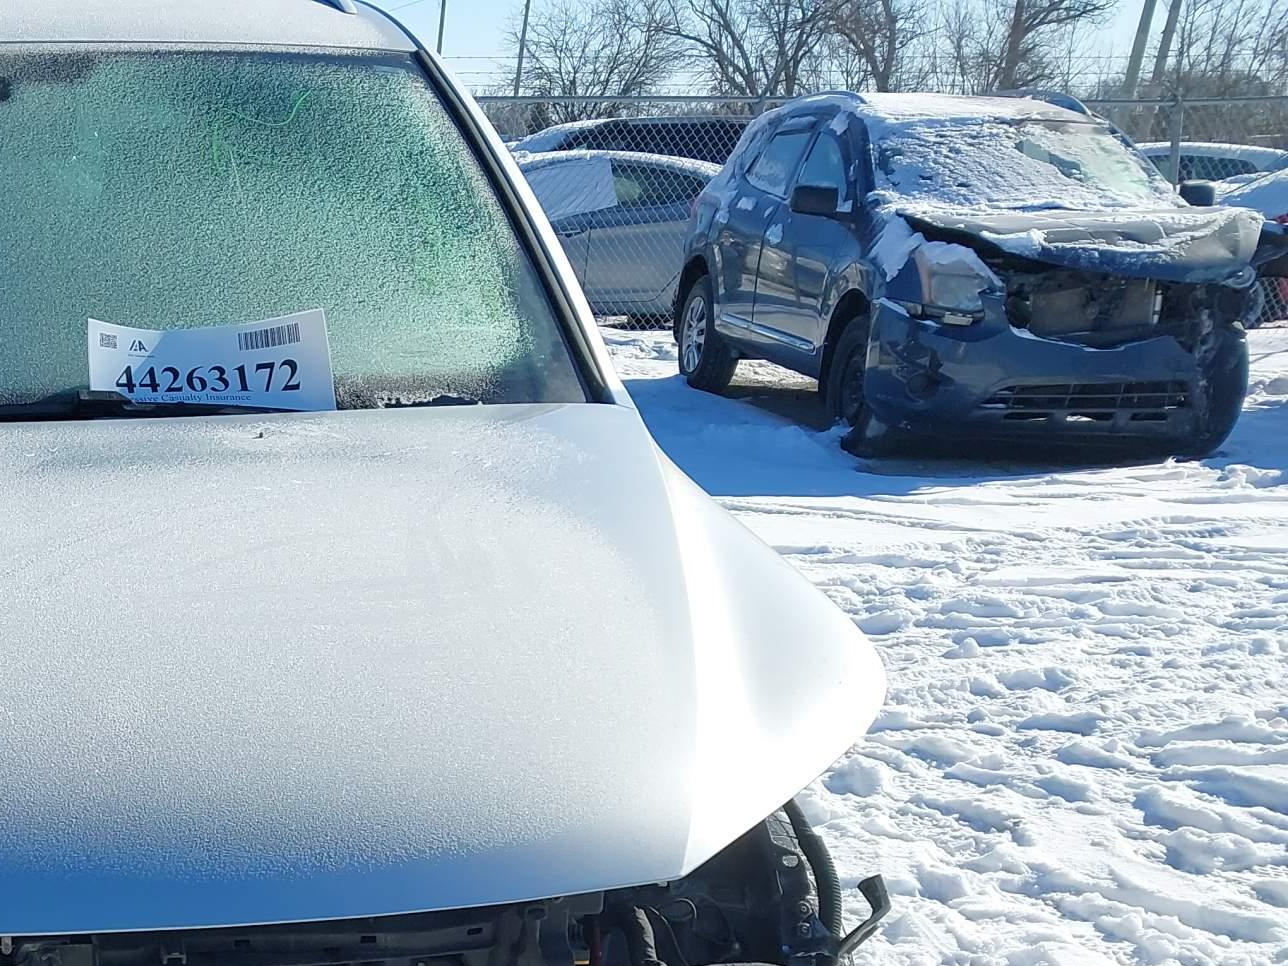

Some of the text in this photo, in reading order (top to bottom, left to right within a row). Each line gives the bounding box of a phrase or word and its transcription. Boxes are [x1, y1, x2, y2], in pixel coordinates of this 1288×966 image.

[115, 358, 301, 393] 44263172
[161, 393, 202, 402] Casualty
[205, 393, 251, 401] Insurance
